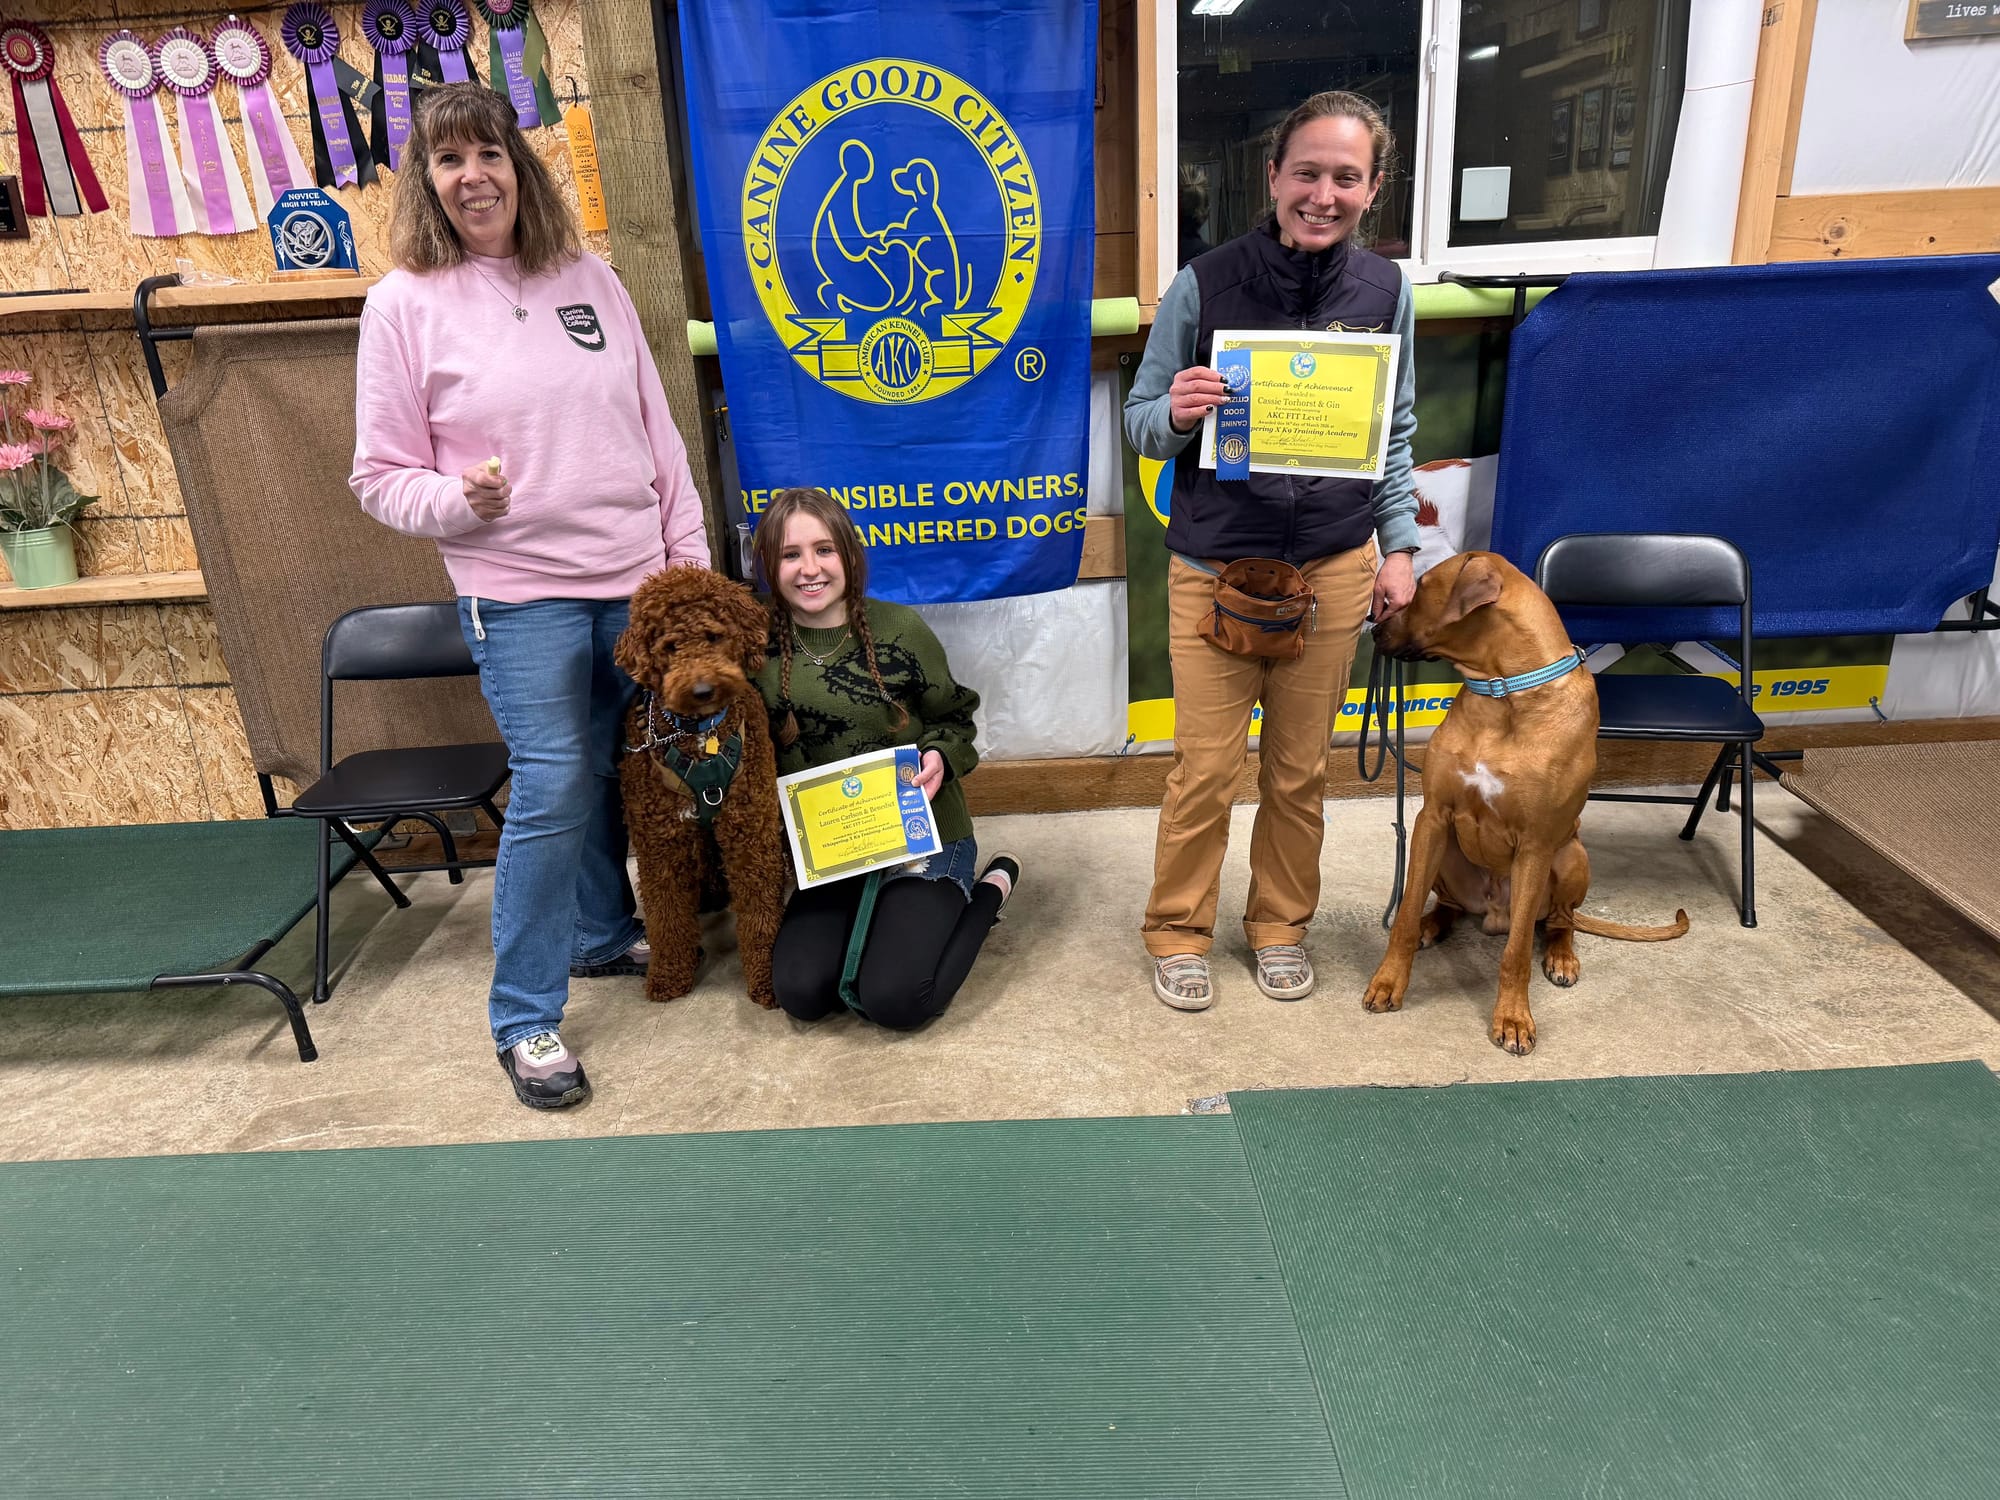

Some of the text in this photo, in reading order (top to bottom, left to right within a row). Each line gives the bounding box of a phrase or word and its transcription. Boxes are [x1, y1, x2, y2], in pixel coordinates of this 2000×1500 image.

[1946, 4, 1987, 18] lives
[748, 66, 1037, 269] CANINE GOOD CITIZEN
[287, 192, 320, 200] NOVICE
[862, 320, 931, 367] AMERICAN KENNEL CLUB
[874, 334, 919, 387] AKC
[873, 383, 905, 398] FOUNDED
[1293, 382, 1302, 390] of
[1304, 382, 1354, 392] Achievement
[1258, 396, 1341, 409] Cassie Torhorst & Gin
[1223, 408, 1245, 416] GOOD
[1266, 411, 1284, 419] AKC
[1286, 412, 1300, 420] FIT
[1302, 413, 1321, 421] Level
[1293, 427, 1324, 436] Training
[1325, 430, 1359, 439] Academy
[943, 472, 1085, 505] OWNERS,
[854, 507, 1087, 547] ANNERED DOGS
[1770, 679, 1831, 696] 1995
[818, 803, 848, 817] Certificate
[819, 817, 841, 828] Lauren
[840, 810, 864, 821] Carlson
